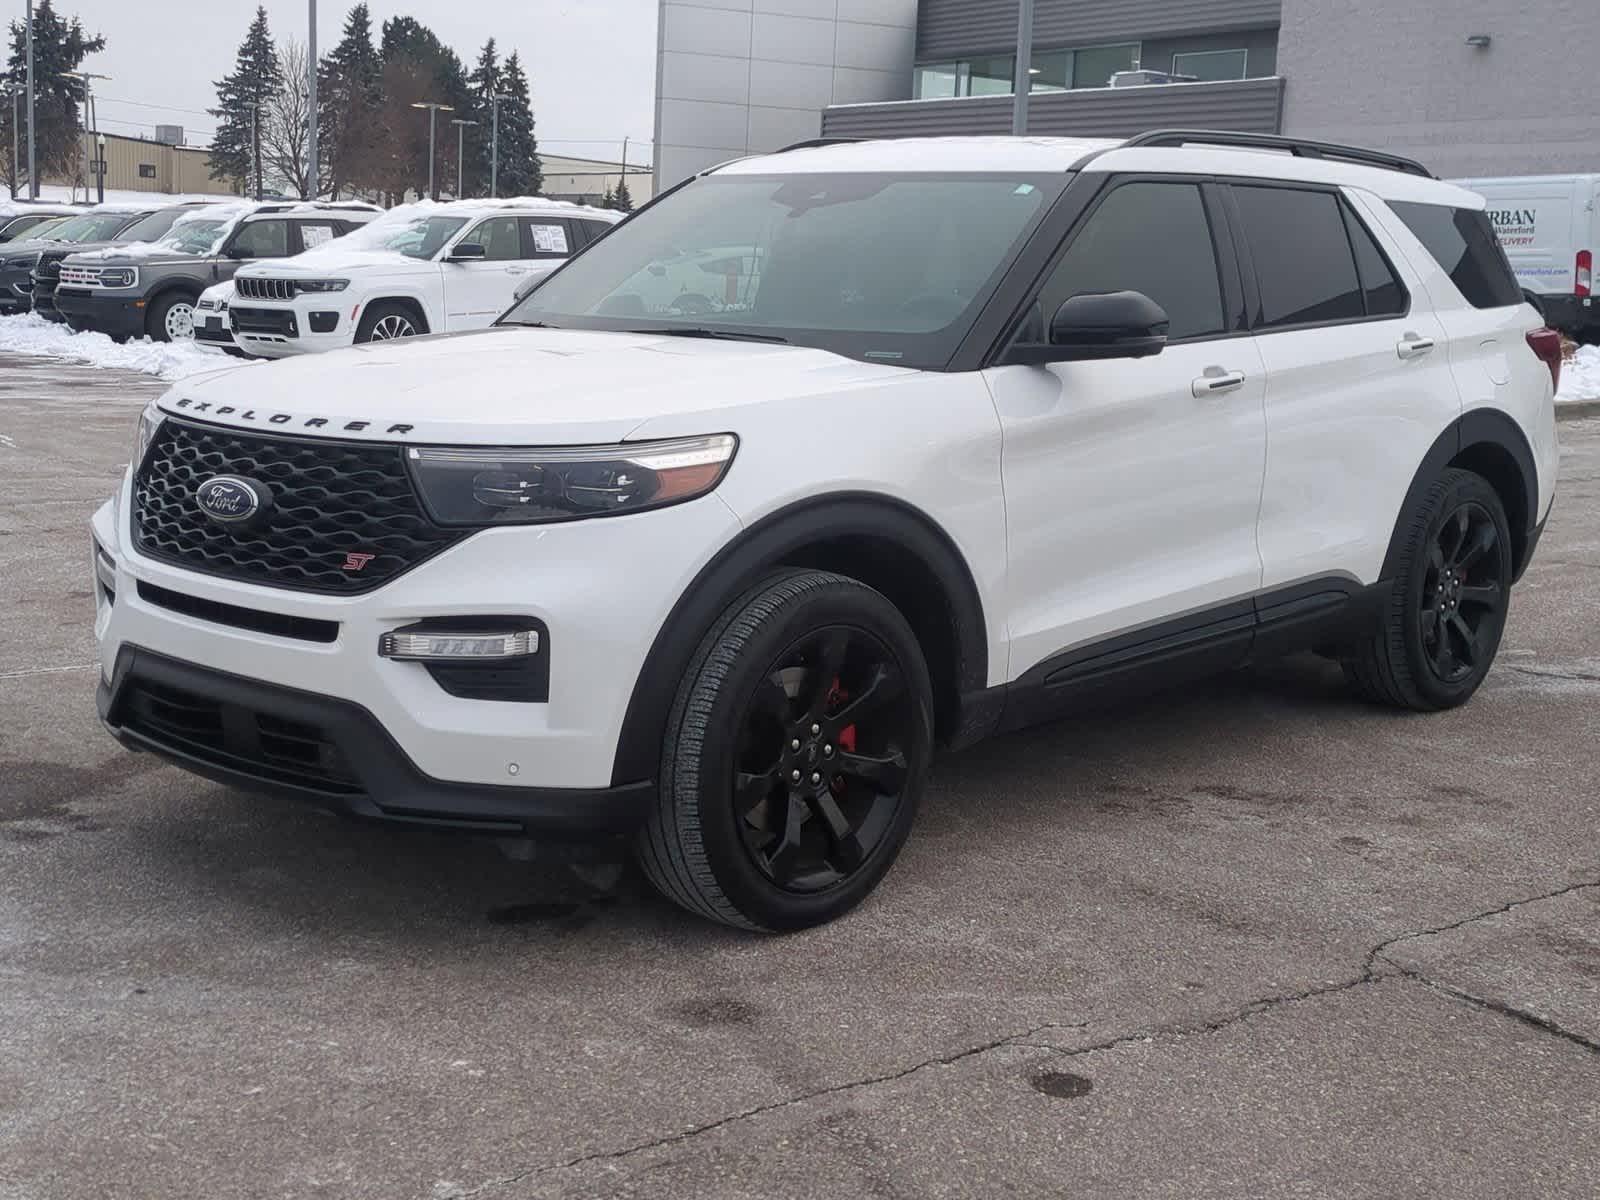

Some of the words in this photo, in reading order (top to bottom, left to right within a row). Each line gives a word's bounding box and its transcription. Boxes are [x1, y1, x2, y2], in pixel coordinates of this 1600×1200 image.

[1488, 209, 1536, 225] RBAN
[1495, 236, 1535, 246] ELIVERY
[175, 398, 414, 435] EXPLORER
[205, 484, 240, 513] Ford
[343, 553, 375, 570] ST
